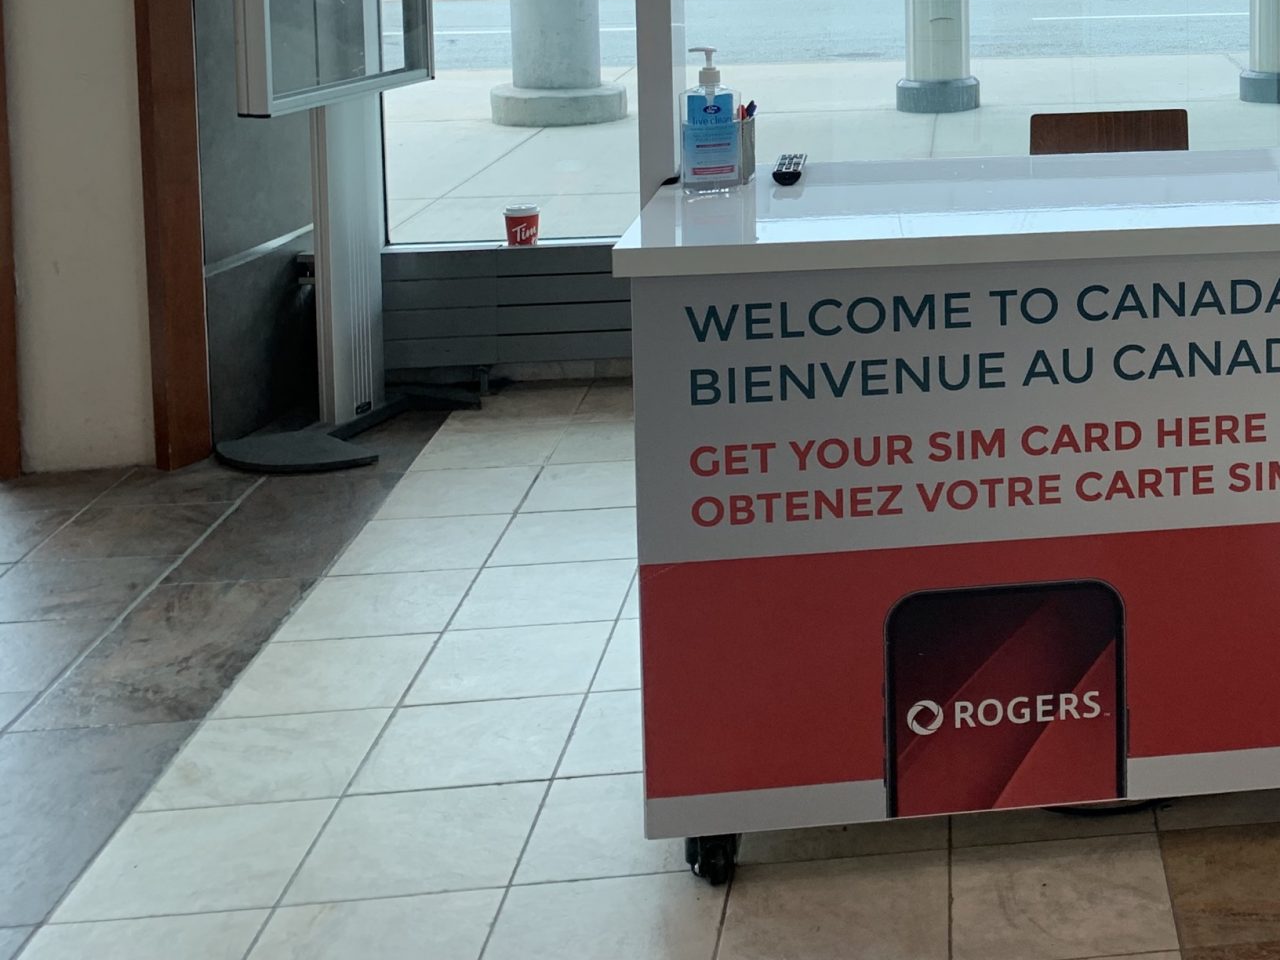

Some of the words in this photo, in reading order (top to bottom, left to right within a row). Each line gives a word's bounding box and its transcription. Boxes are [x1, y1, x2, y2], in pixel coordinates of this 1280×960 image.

[684, 291, 972, 343] WELCOME
[988, 287, 1059, 326] TO
[690, 351, 1006, 406] BIENVENUE
[1022, 347, 1094, 387] AU
[690, 443, 777, 477] GET
[790, 435, 912, 470] YOUR
[928, 428, 1006, 463] SIM
[1020, 421, 1142, 457] CARD
[1156, 413, 1266, 449] HERE
[691, 485, 903, 527] OBTENEZ
[916, 474, 1062, 513] VOTRE
[1076, 464, 1216, 502] CARTE
[954, 690, 1101, 729] ROGERS
